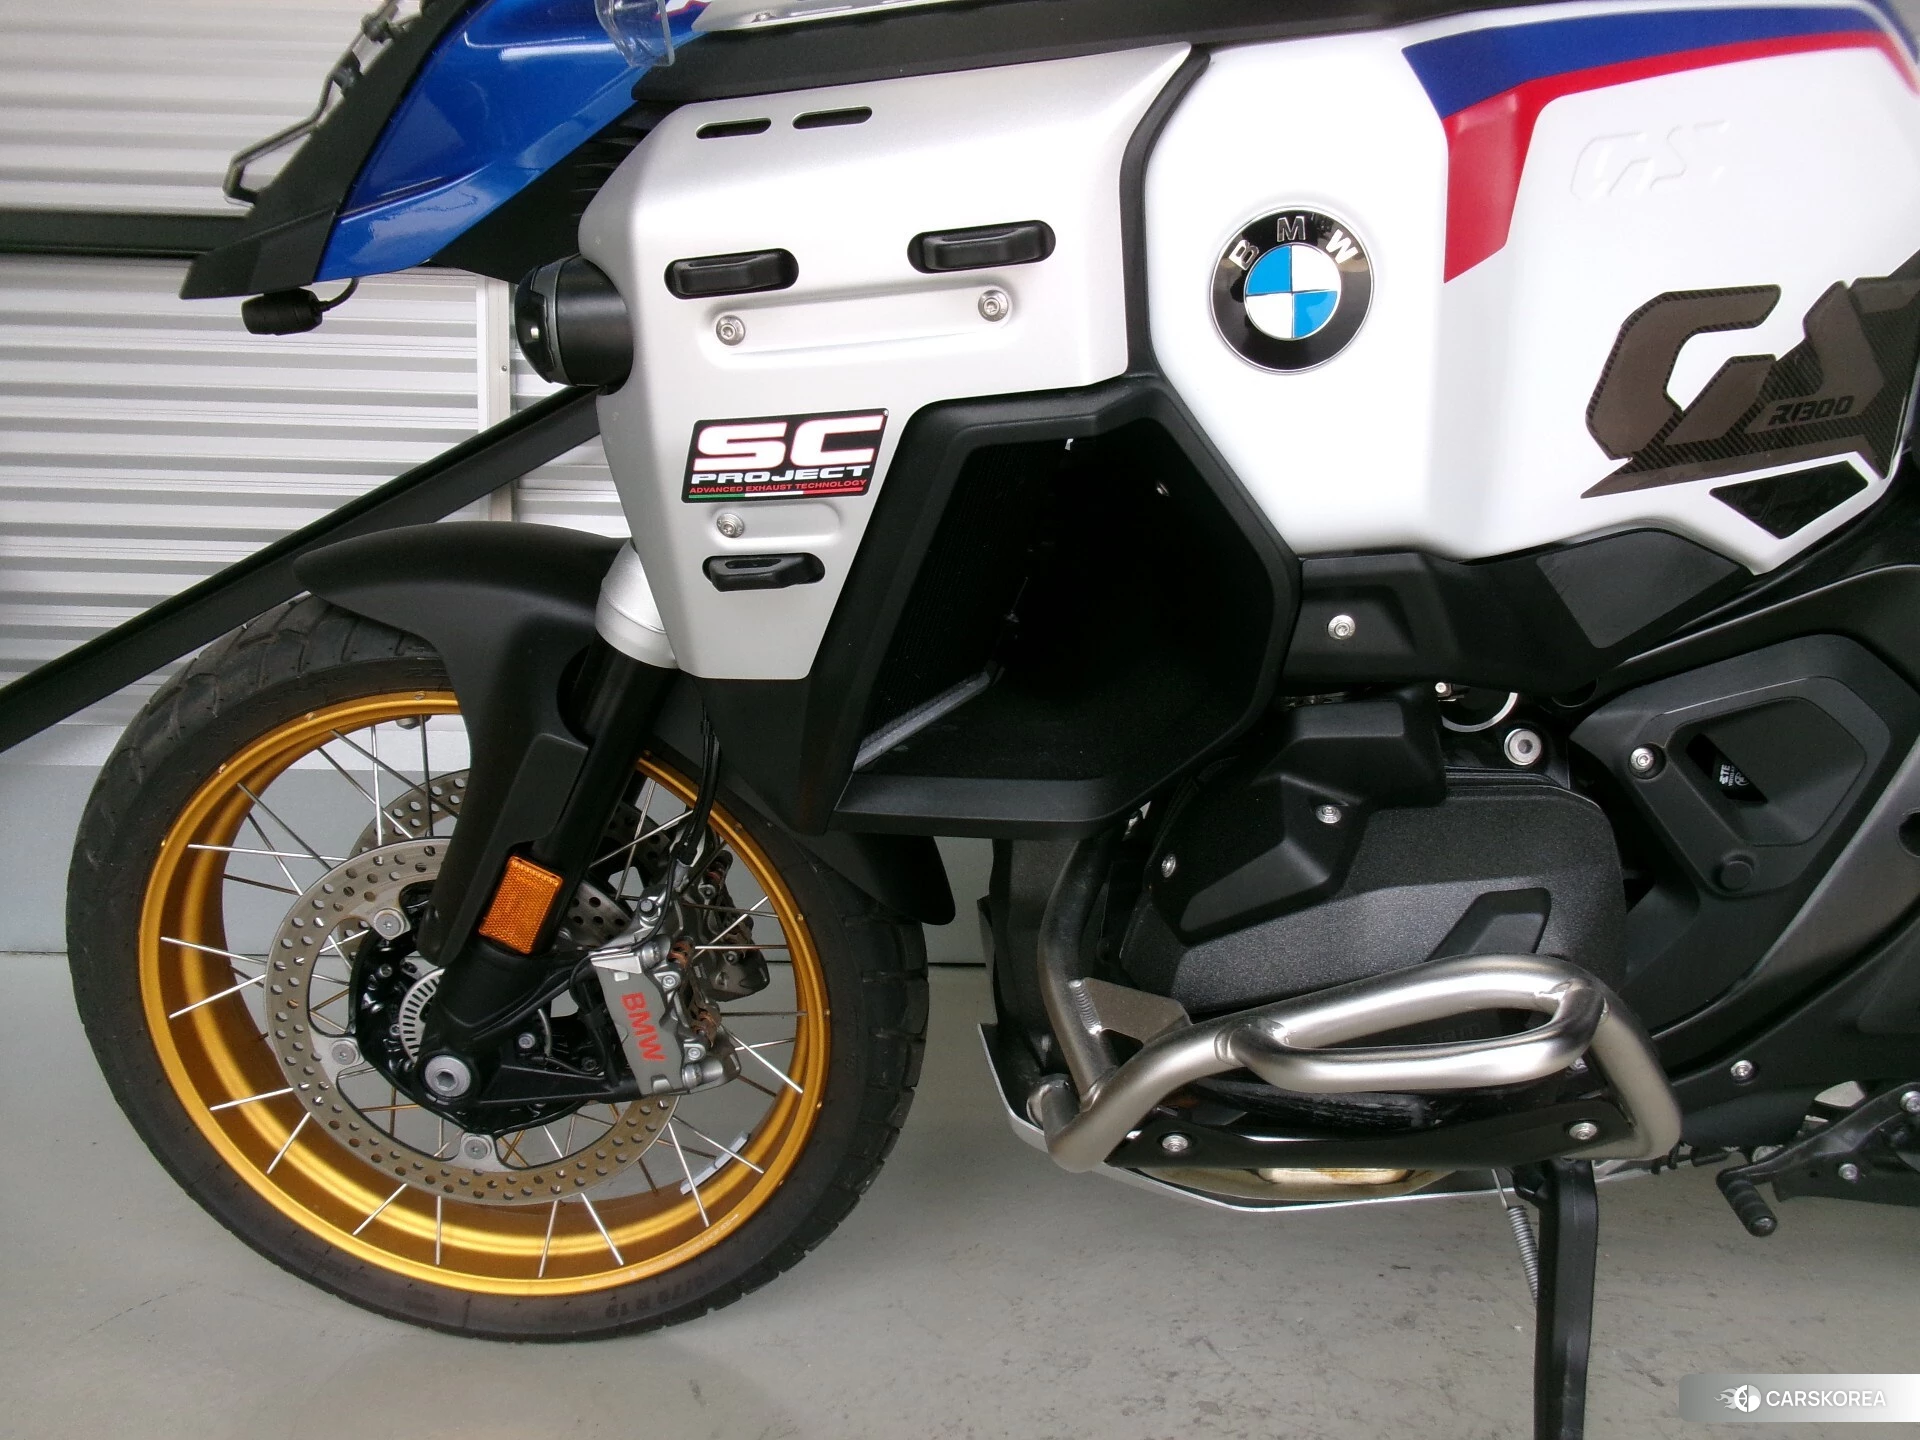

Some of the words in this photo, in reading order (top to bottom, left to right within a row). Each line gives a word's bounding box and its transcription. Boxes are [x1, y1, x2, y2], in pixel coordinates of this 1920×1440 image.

[1228, 215, 1359, 271] BMW
[1767, 395, 1855, 426] R1300
[693, 414, 884, 471] SC
[689, 485, 743, 494] ADVANCED
[745, 483, 792, 491] EXHAUST
[795, 479, 868, 490] TECHNOLOGY
[691, 465, 870, 485] PROJECT
[621, 992, 667, 1061] BMW
